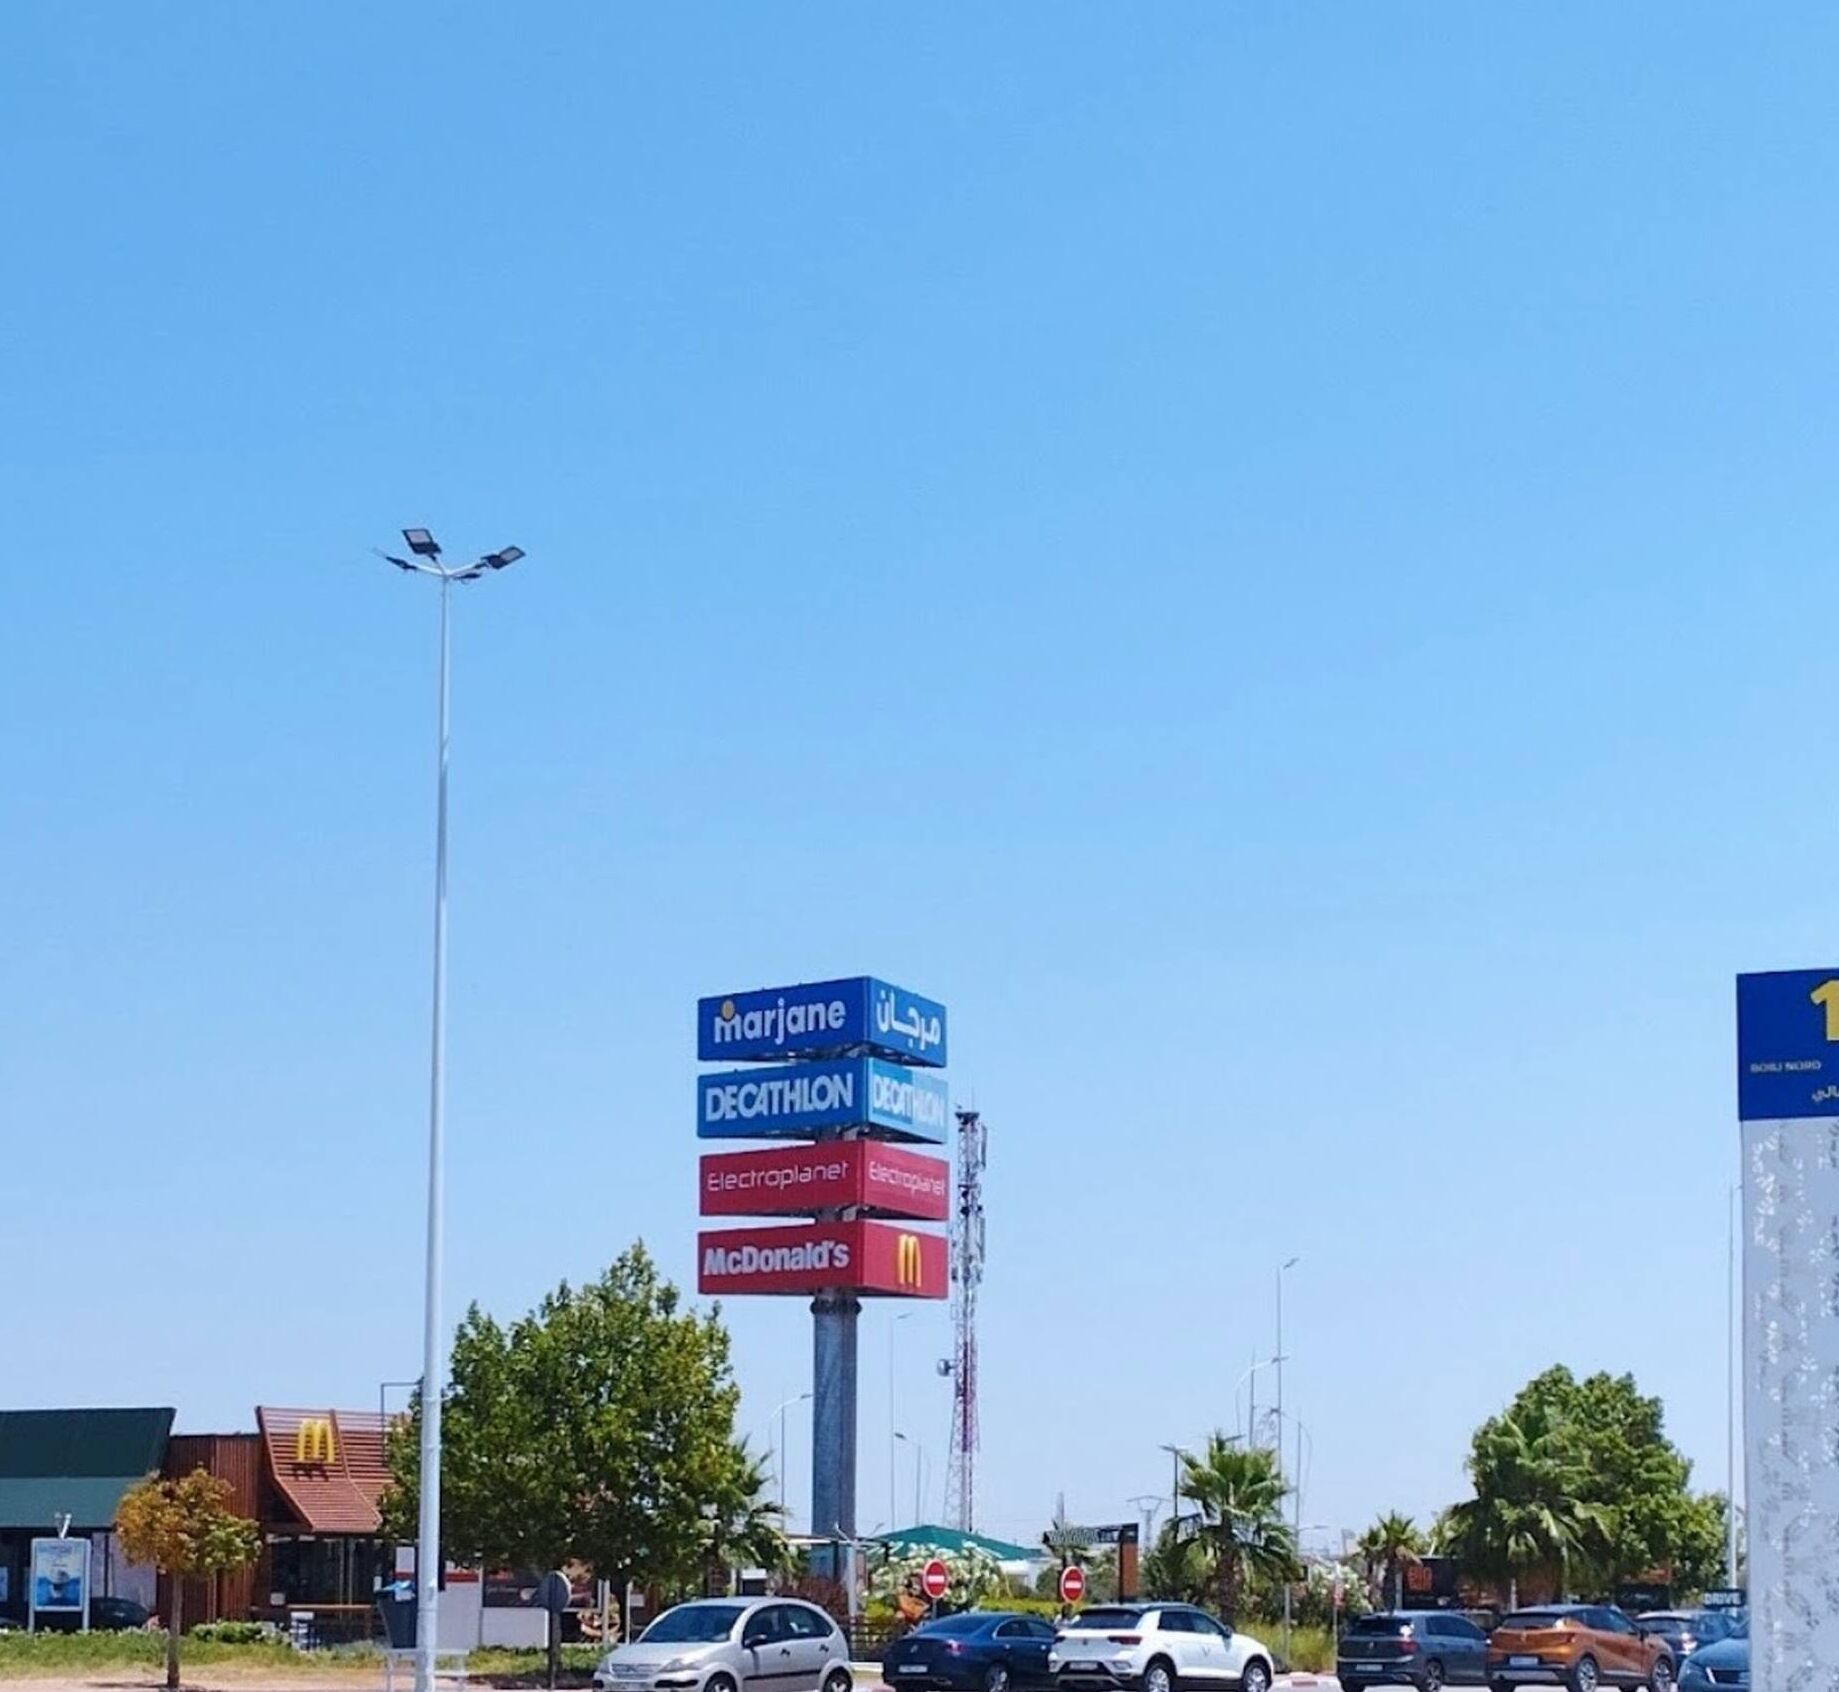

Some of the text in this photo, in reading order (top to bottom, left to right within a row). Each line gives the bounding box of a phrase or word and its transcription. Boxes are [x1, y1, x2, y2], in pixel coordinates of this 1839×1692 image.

[714, 998, 846, 1044] marjane
[876, 988, 941, 1051] مرجان
[705, 1073, 854, 1122] DECATHLON
[708, 1160, 850, 1191] Electroplanet
[703, 1240, 849, 1275] McDonald's
